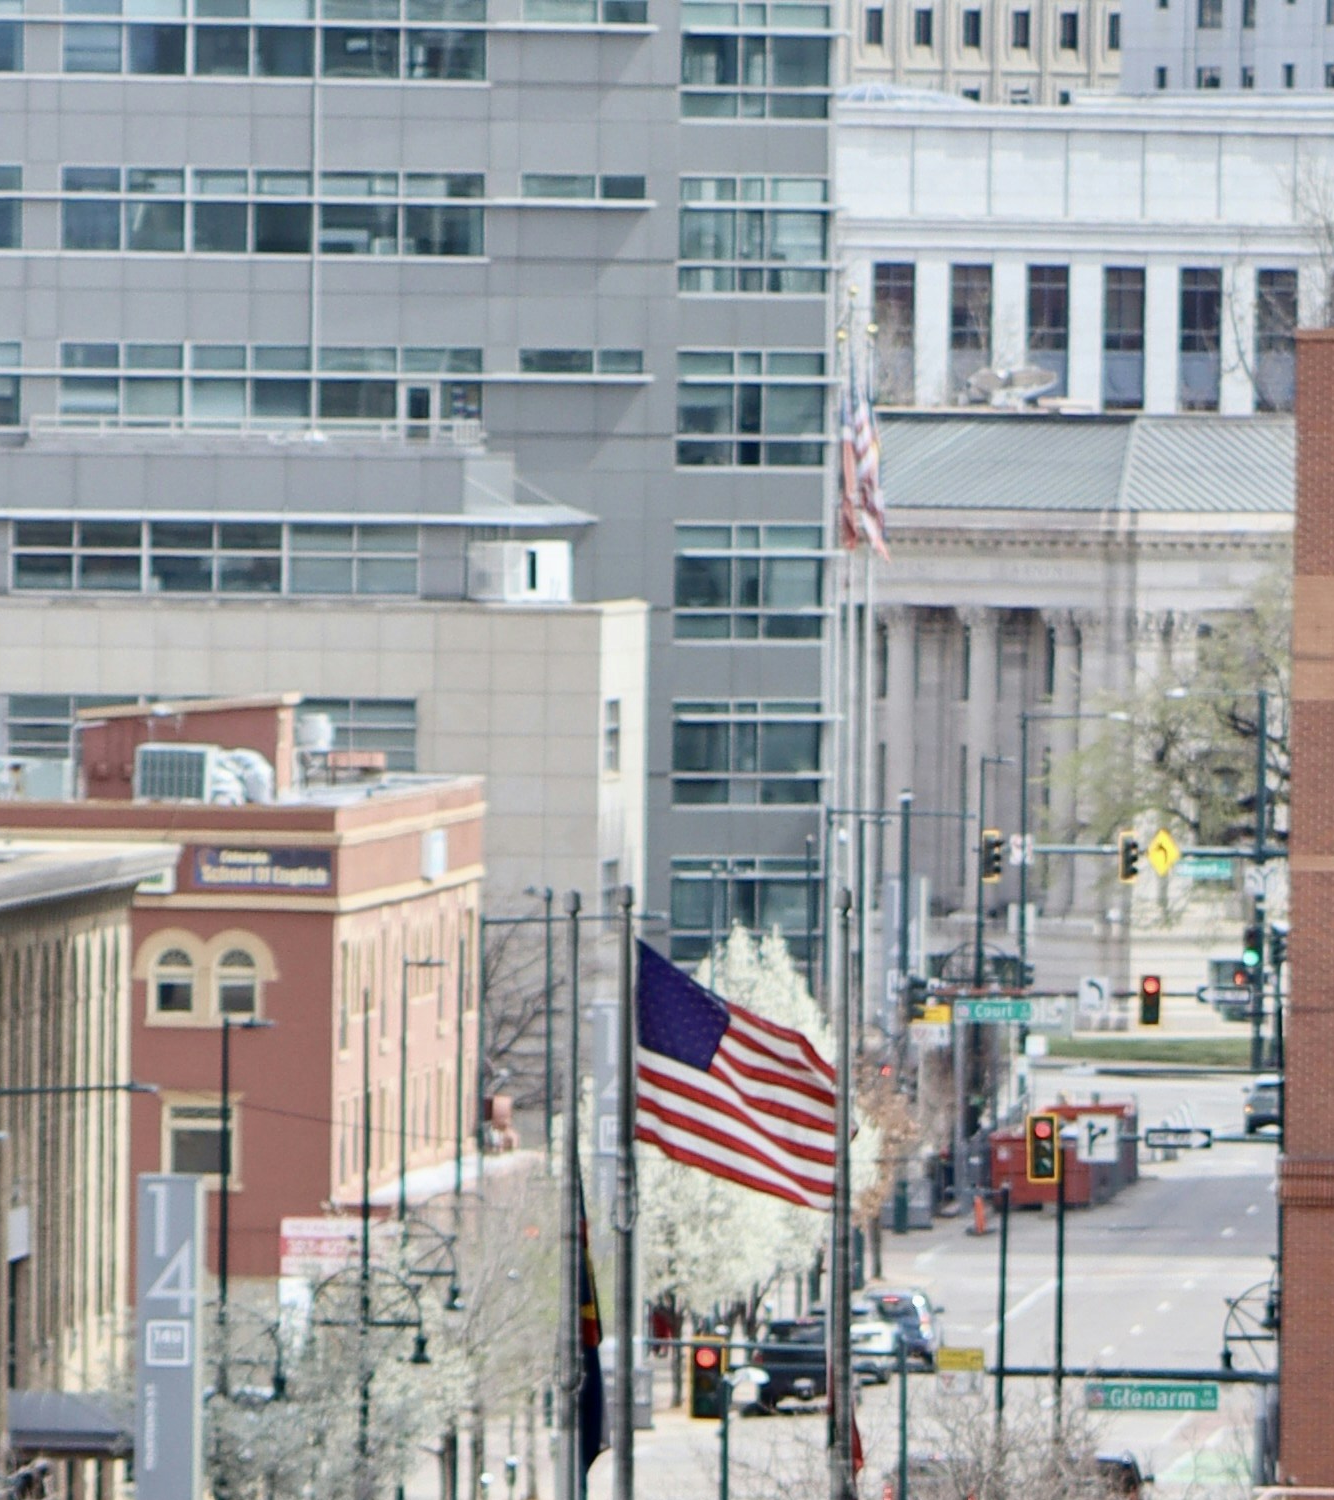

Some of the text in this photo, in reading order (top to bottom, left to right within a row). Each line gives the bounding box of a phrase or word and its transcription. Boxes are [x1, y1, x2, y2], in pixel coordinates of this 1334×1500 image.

[202, 864, 252, 883] School
[272, 865, 329, 886] English
[1110, 1388, 1196, 1408] Glenarm
